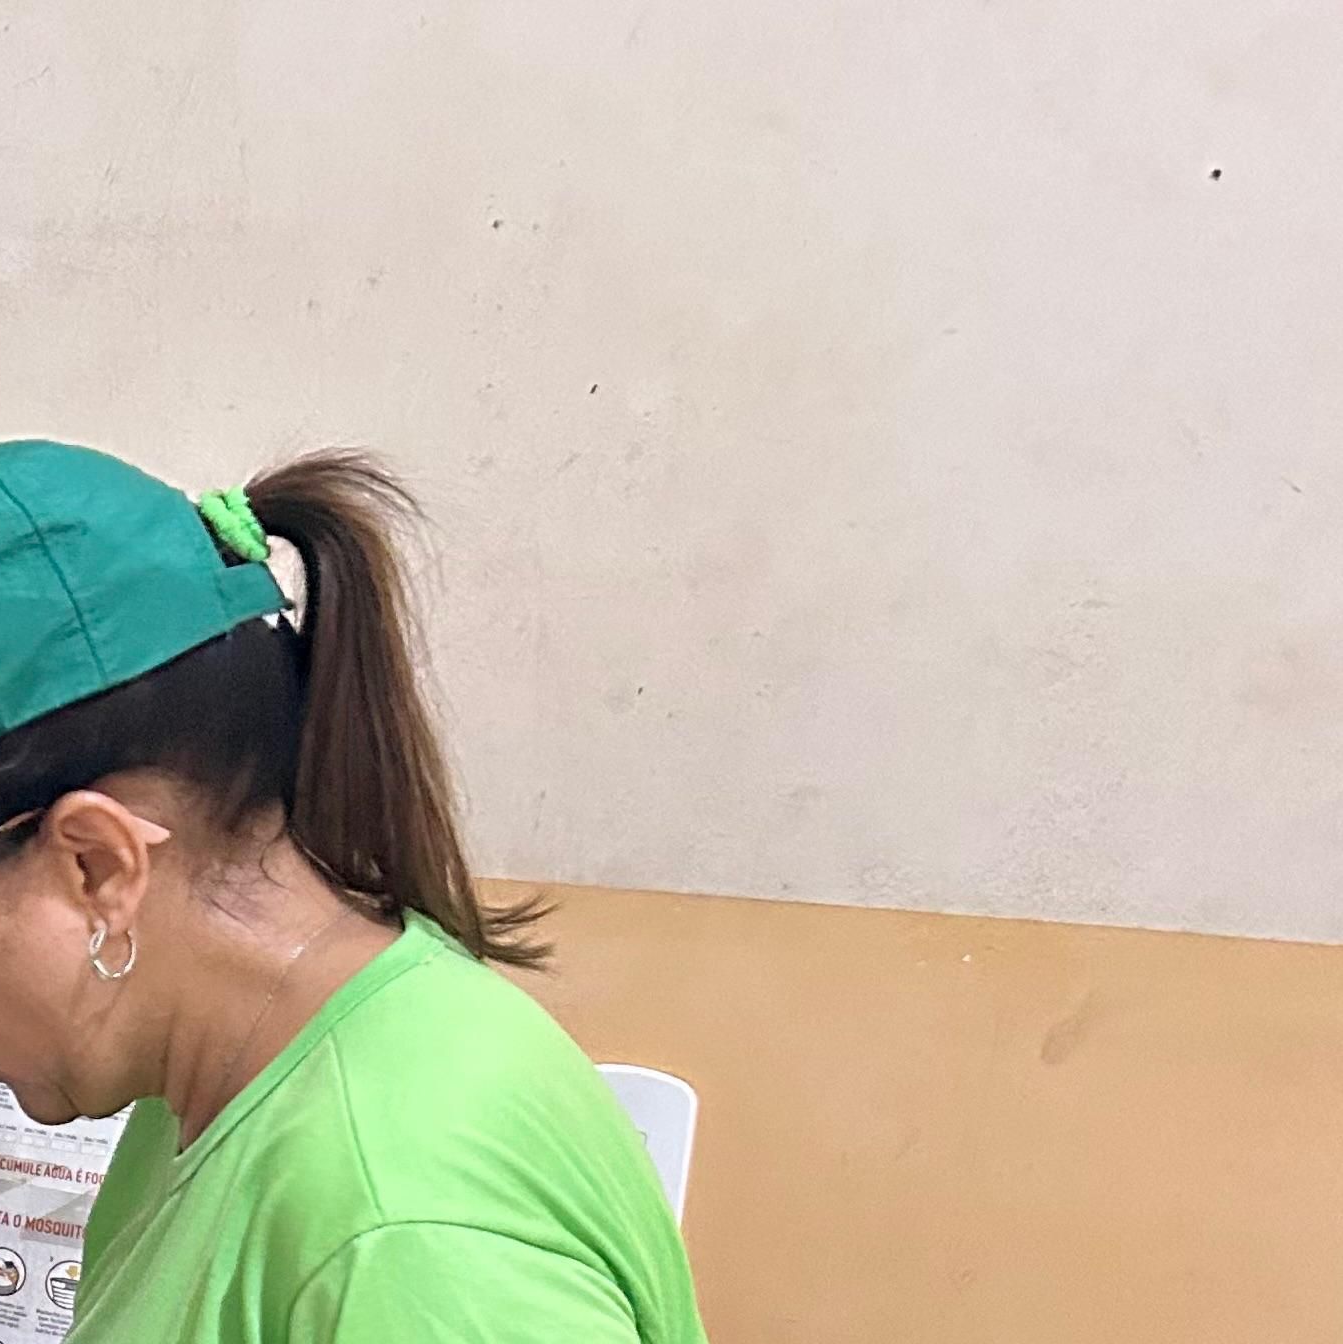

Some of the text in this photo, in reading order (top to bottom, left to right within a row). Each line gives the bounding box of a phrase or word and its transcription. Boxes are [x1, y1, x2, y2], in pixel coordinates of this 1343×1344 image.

[76, 1167, 84, 1184] É
[85, 1172, 106, 1186] FOC
[13, 1213, 21, 1228] O
